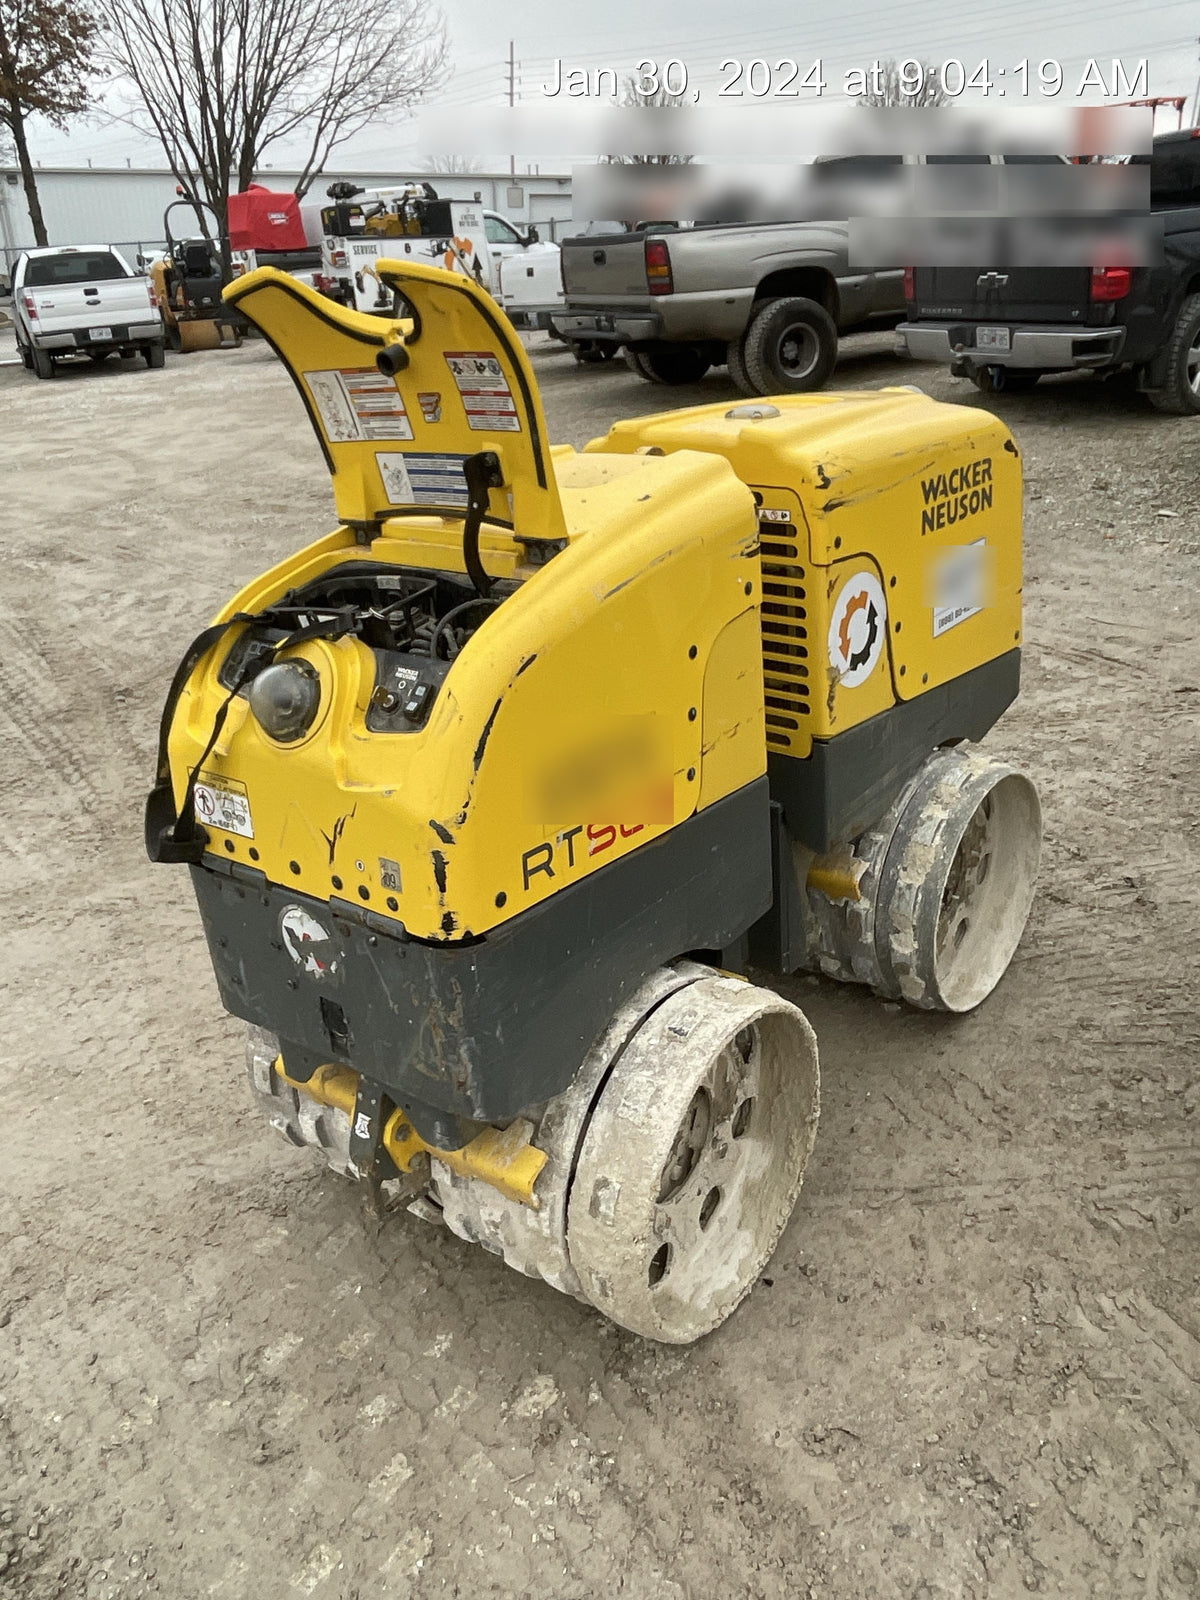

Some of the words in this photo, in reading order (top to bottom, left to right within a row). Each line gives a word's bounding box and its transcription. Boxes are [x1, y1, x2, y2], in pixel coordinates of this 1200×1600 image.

[352, 244, 378, 256] SERVICE
[921, 457, 992, 505] WACKER
[921, 484, 993, 536] NEUSON
